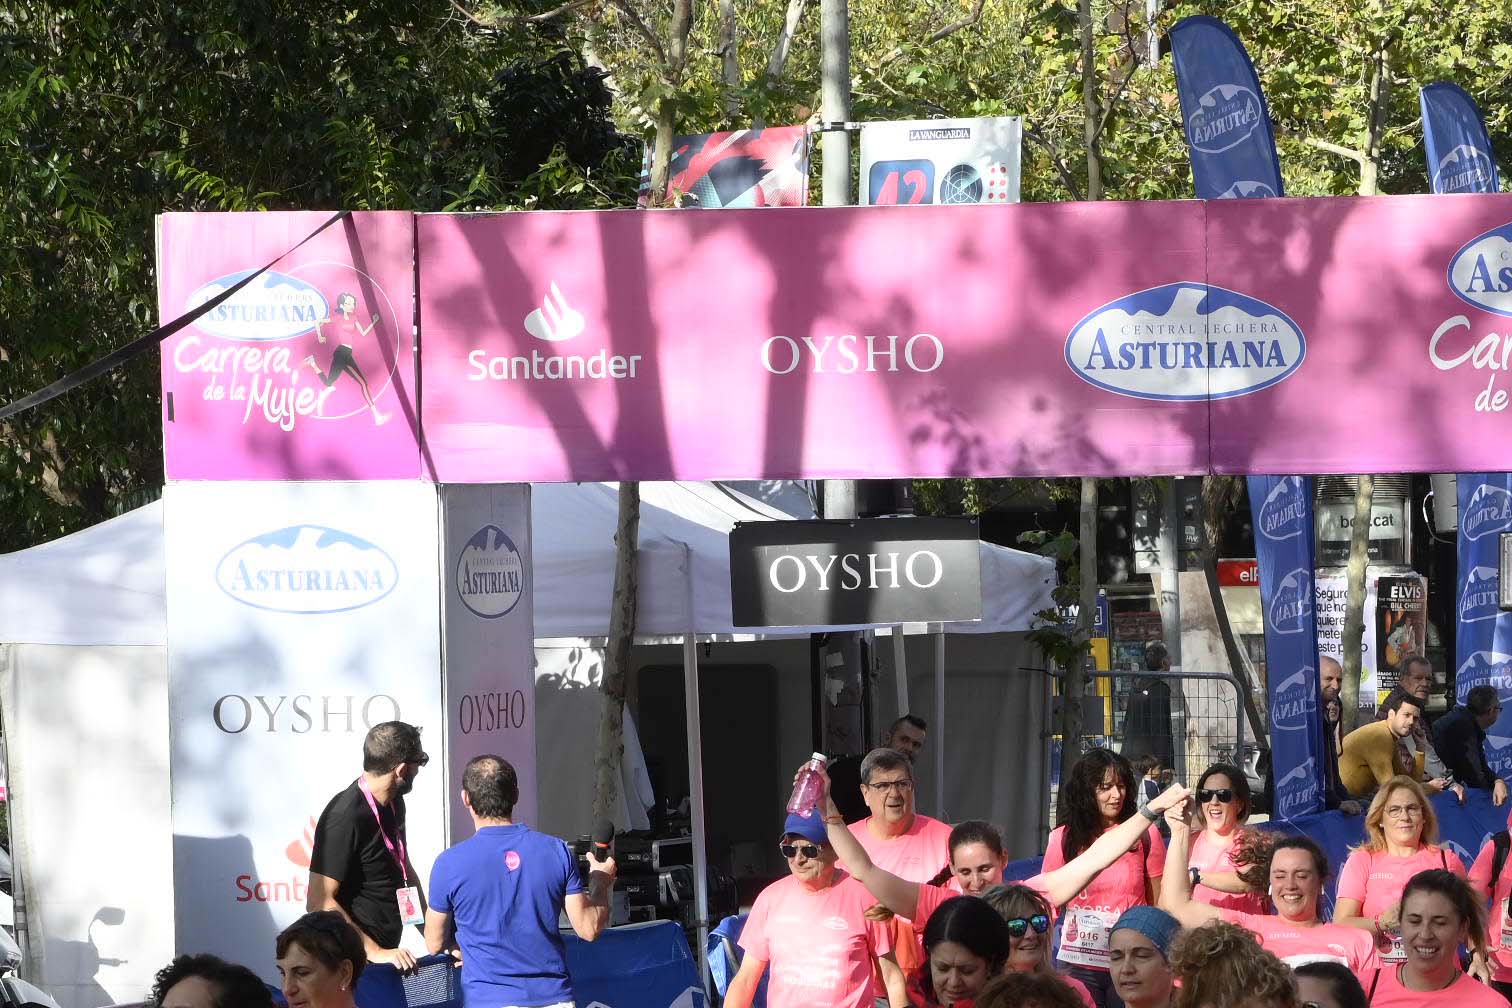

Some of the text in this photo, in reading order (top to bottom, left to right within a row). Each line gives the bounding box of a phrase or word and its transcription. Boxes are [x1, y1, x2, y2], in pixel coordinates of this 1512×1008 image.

[1084, 327, 1288, 371] ASTURIANA
[1120, 324, 1200, 336] CENTRAL
[174, 335, 291, 373] Carrera
[468, 349, 642, 381] Santander
[760, 333, 944, 375] OYSHO
[203, 370, 336, 432] de la Mujer
[1475, 373, 1509, 412] de
[231, 558, 385, 592] ASTURIANA
[462, 565, 520, 595] ASTURIANA
[768, 549, 944, 593] OYSHO
[1390, 586, 1421, 598] ELVIS
[213, 694, 401, 734] OYSHO
[459, 689, 526, 734] OYSHO
[1079, 930, 1099, 941] 016
